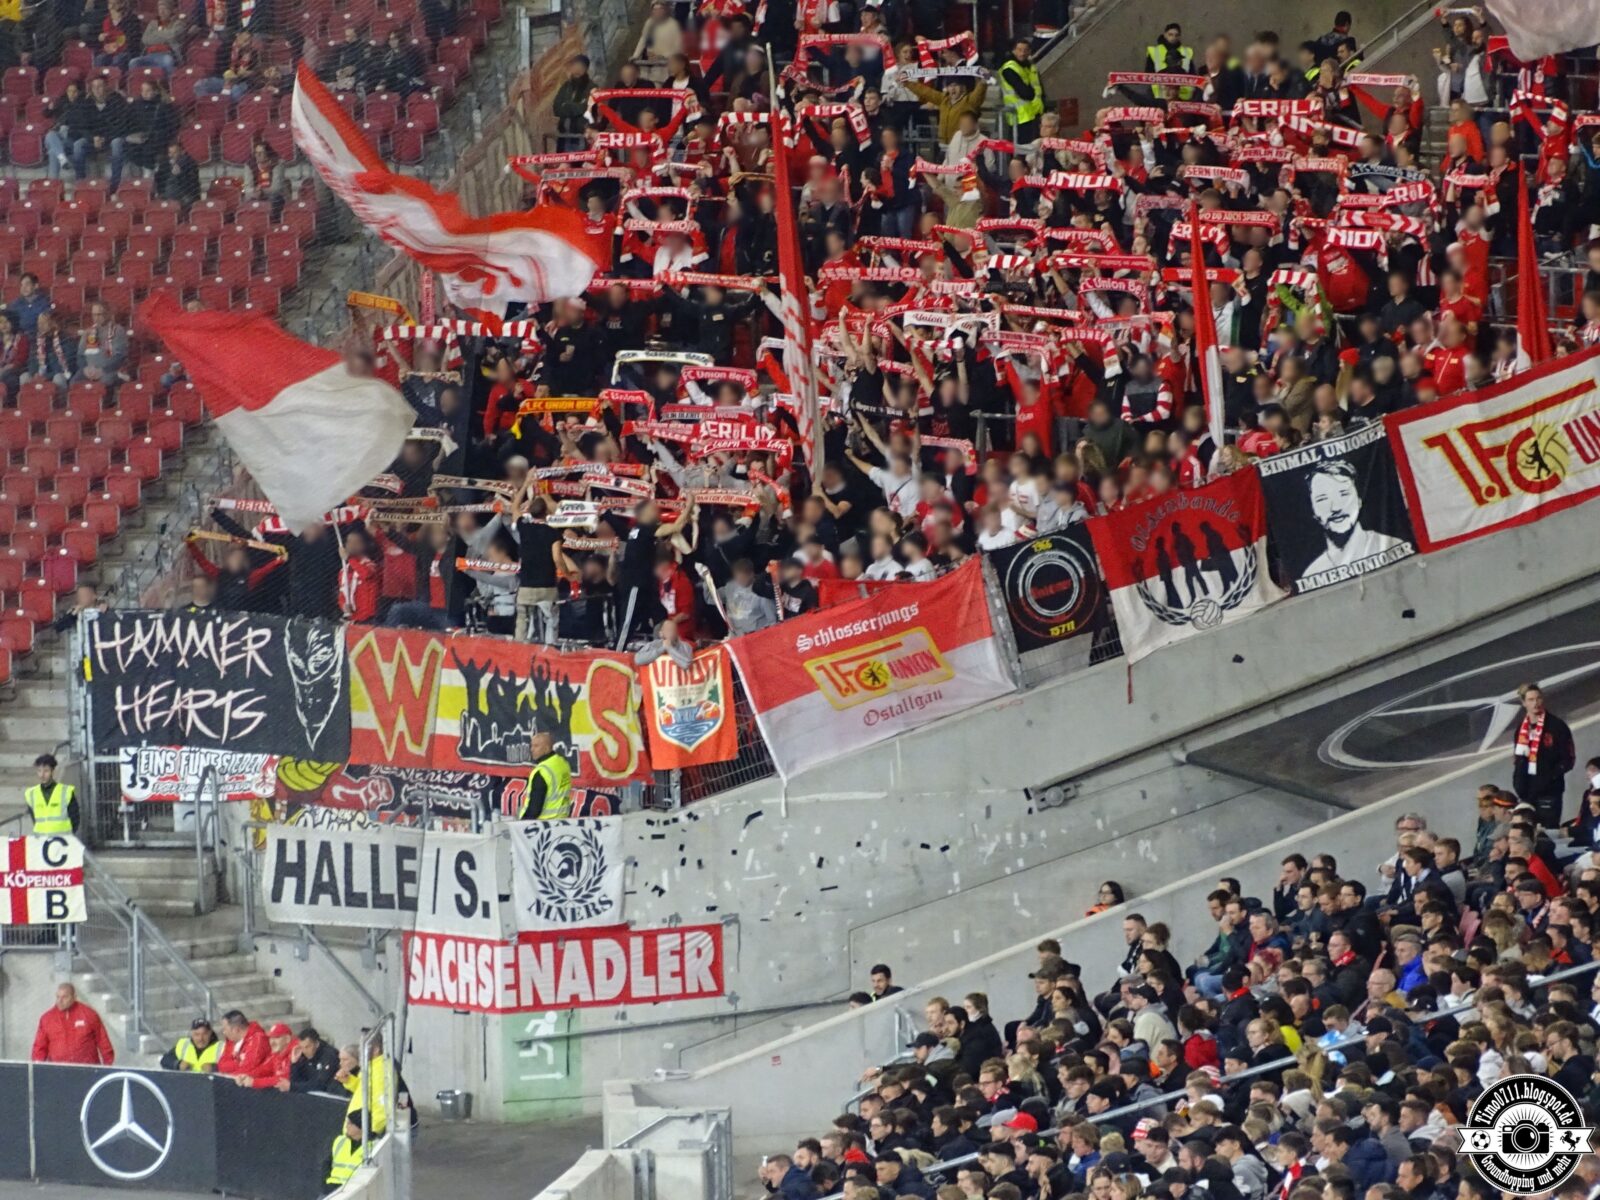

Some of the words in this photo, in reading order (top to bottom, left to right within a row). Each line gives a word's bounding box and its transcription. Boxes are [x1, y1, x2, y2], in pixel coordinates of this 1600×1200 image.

[539, 155, 567, 163] Union
[569, 153, 597, 161] Berlin
[1094, 278, 1127, 291] Union
[696, 371, 727, 380] Union
[610, 391, 643, 401] Union
[1259, 449, 1322, 477] EINMAL
[1322, 425, 1387, 458] UNIONER
[1295, 565, 1352, 594] IMMER
[1351, 541, 1416, 576] UNIONER
[796, 602, 920, 653] Schlosserjungs
[93, 617, 274, 679] HAMMER
[887, 650, 942, 681] UNION
[114, 679, 268, 744] HEARTS
[350, 631, 446, 762] W
[586, 659, 648, 780] S
[139, 750, 178, 776] EINS
[42, 836, 69, 868] C
[4, 870, 72, 888] KÖPENICK
[271, 838, 419, 912] HALLE
[454, 850, 491, 919] S.
[46, 889, 70, 920] B
[528, 894, 614, 923] NINERS
[408, 930, 718, 1009] SACHSENADLER
